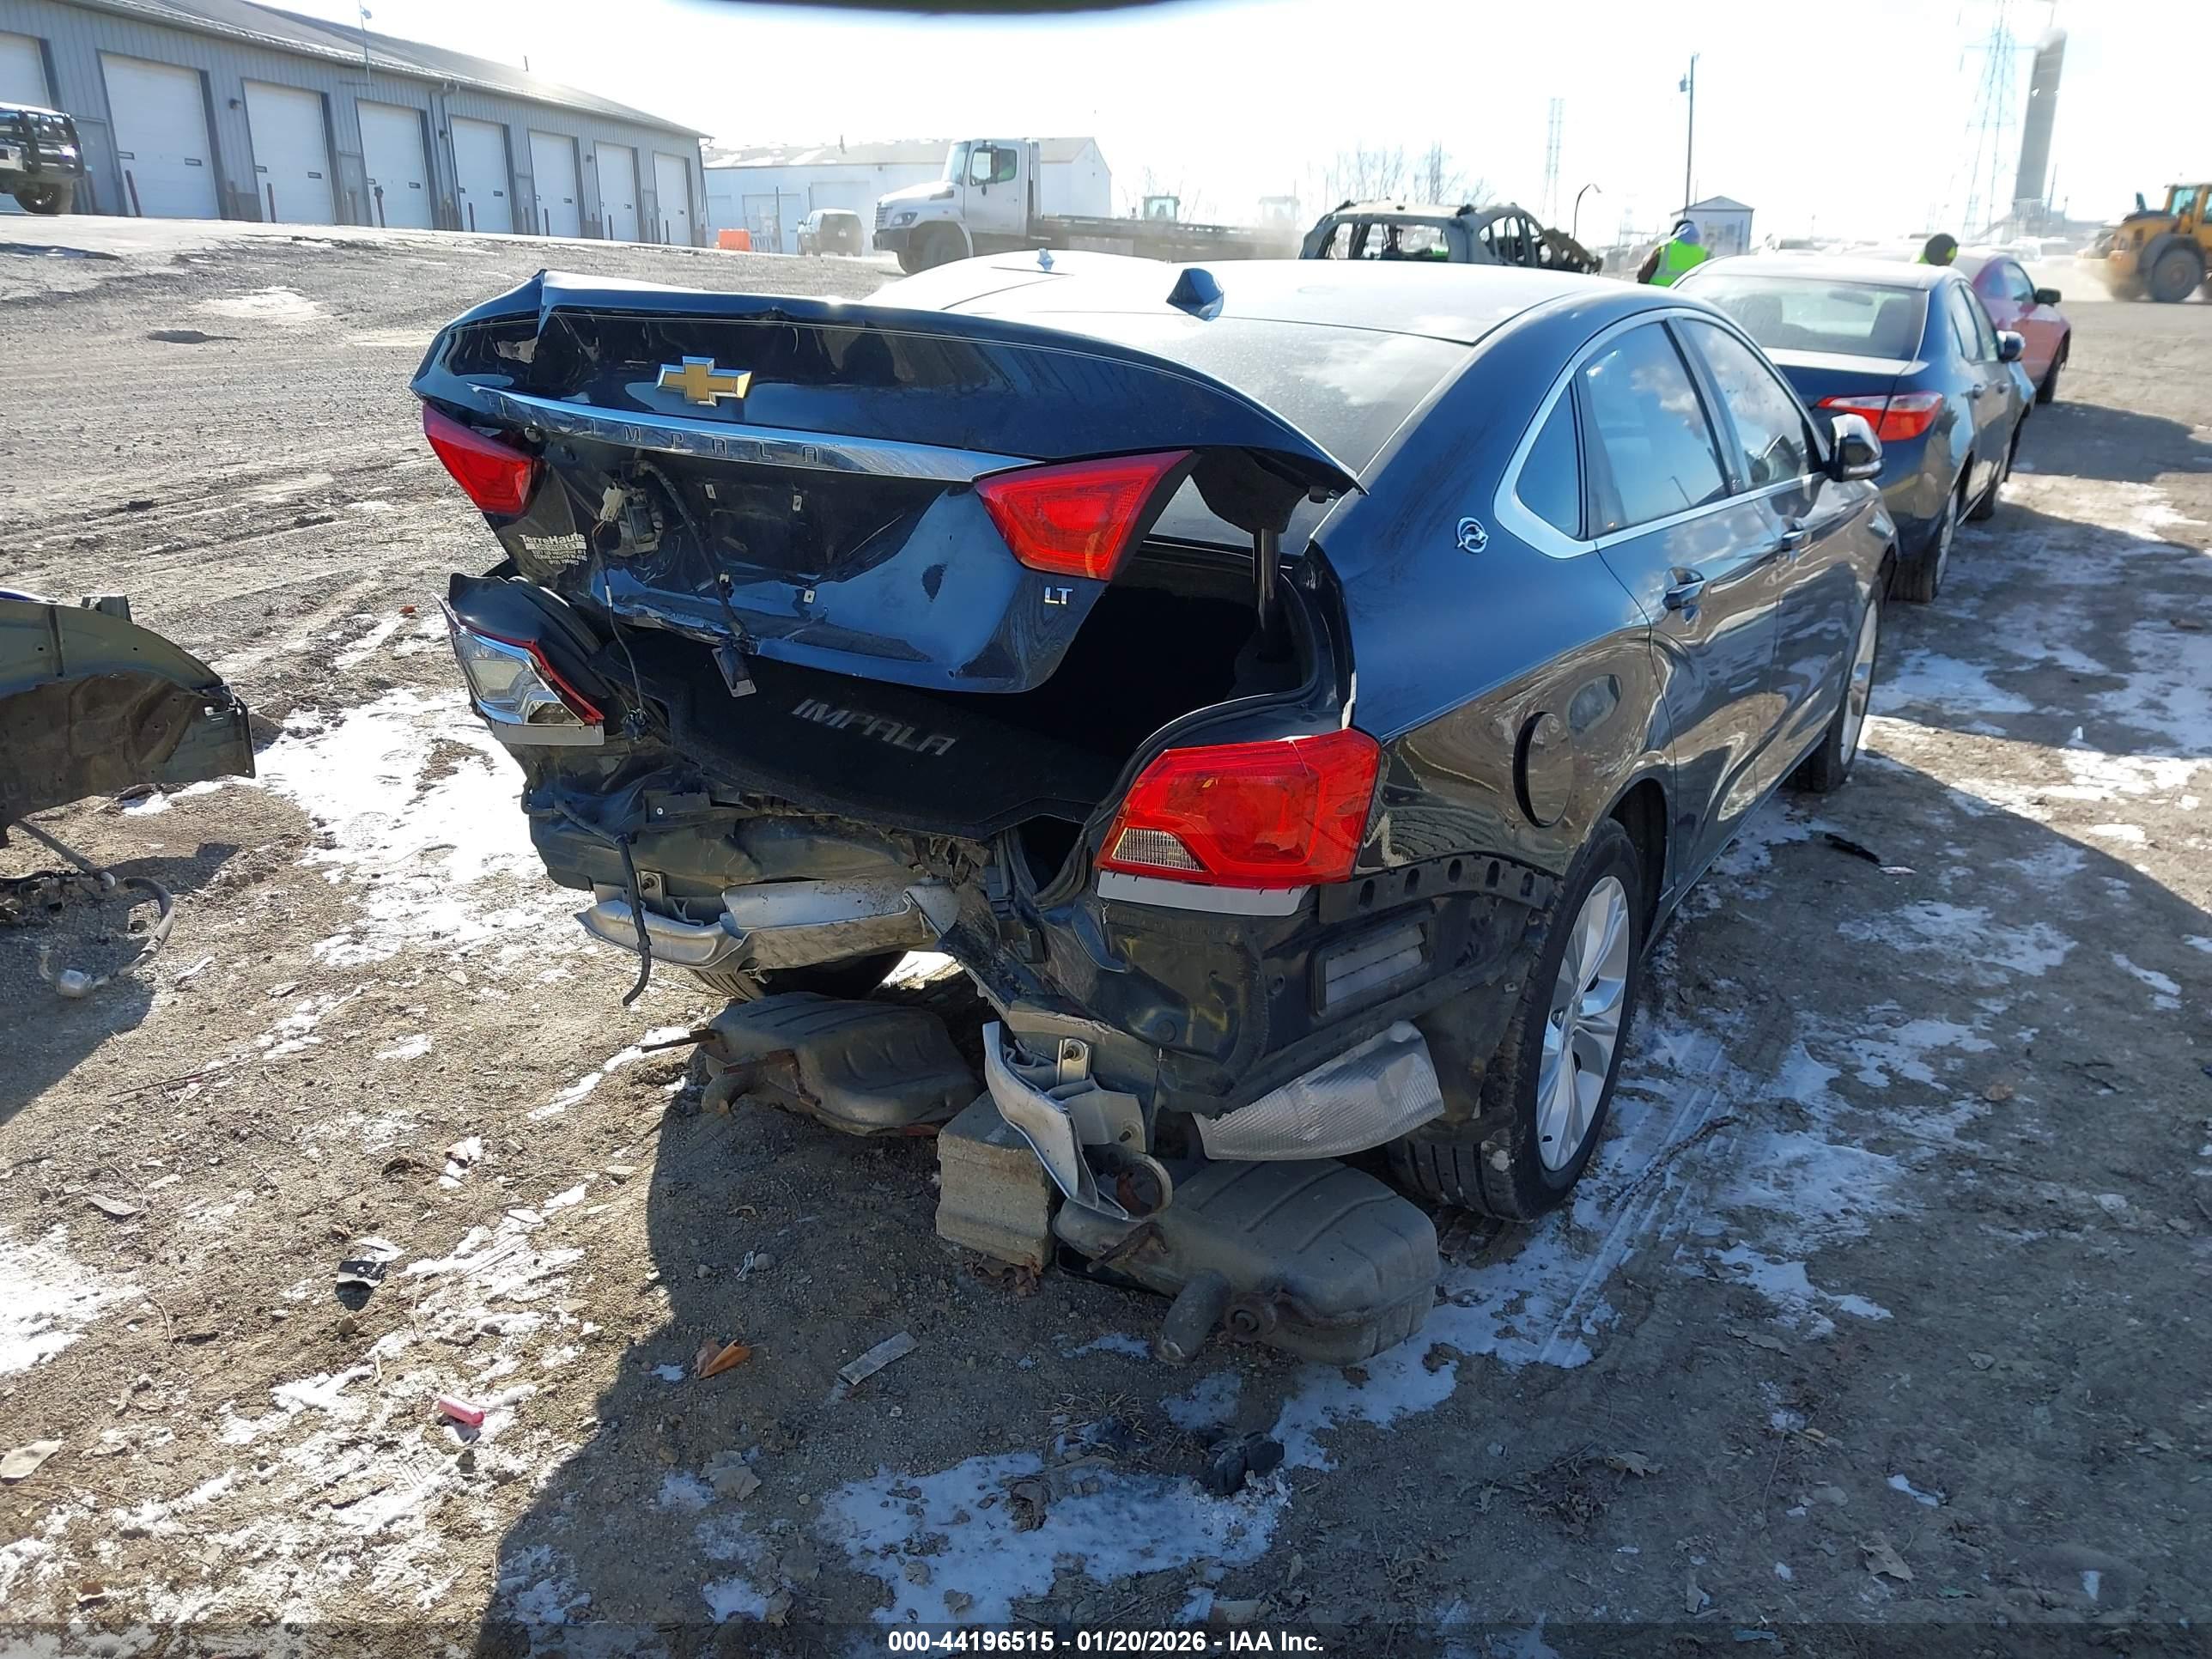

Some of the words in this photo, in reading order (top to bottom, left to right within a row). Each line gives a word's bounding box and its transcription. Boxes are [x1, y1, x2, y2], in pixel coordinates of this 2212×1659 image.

[589, 419, 819, 464] IMPALA
[518, 532, 586, 545] TerreHaute
[1044, 586, 1073, 605] LT
[791, 698, 957, 756] IMPALA
